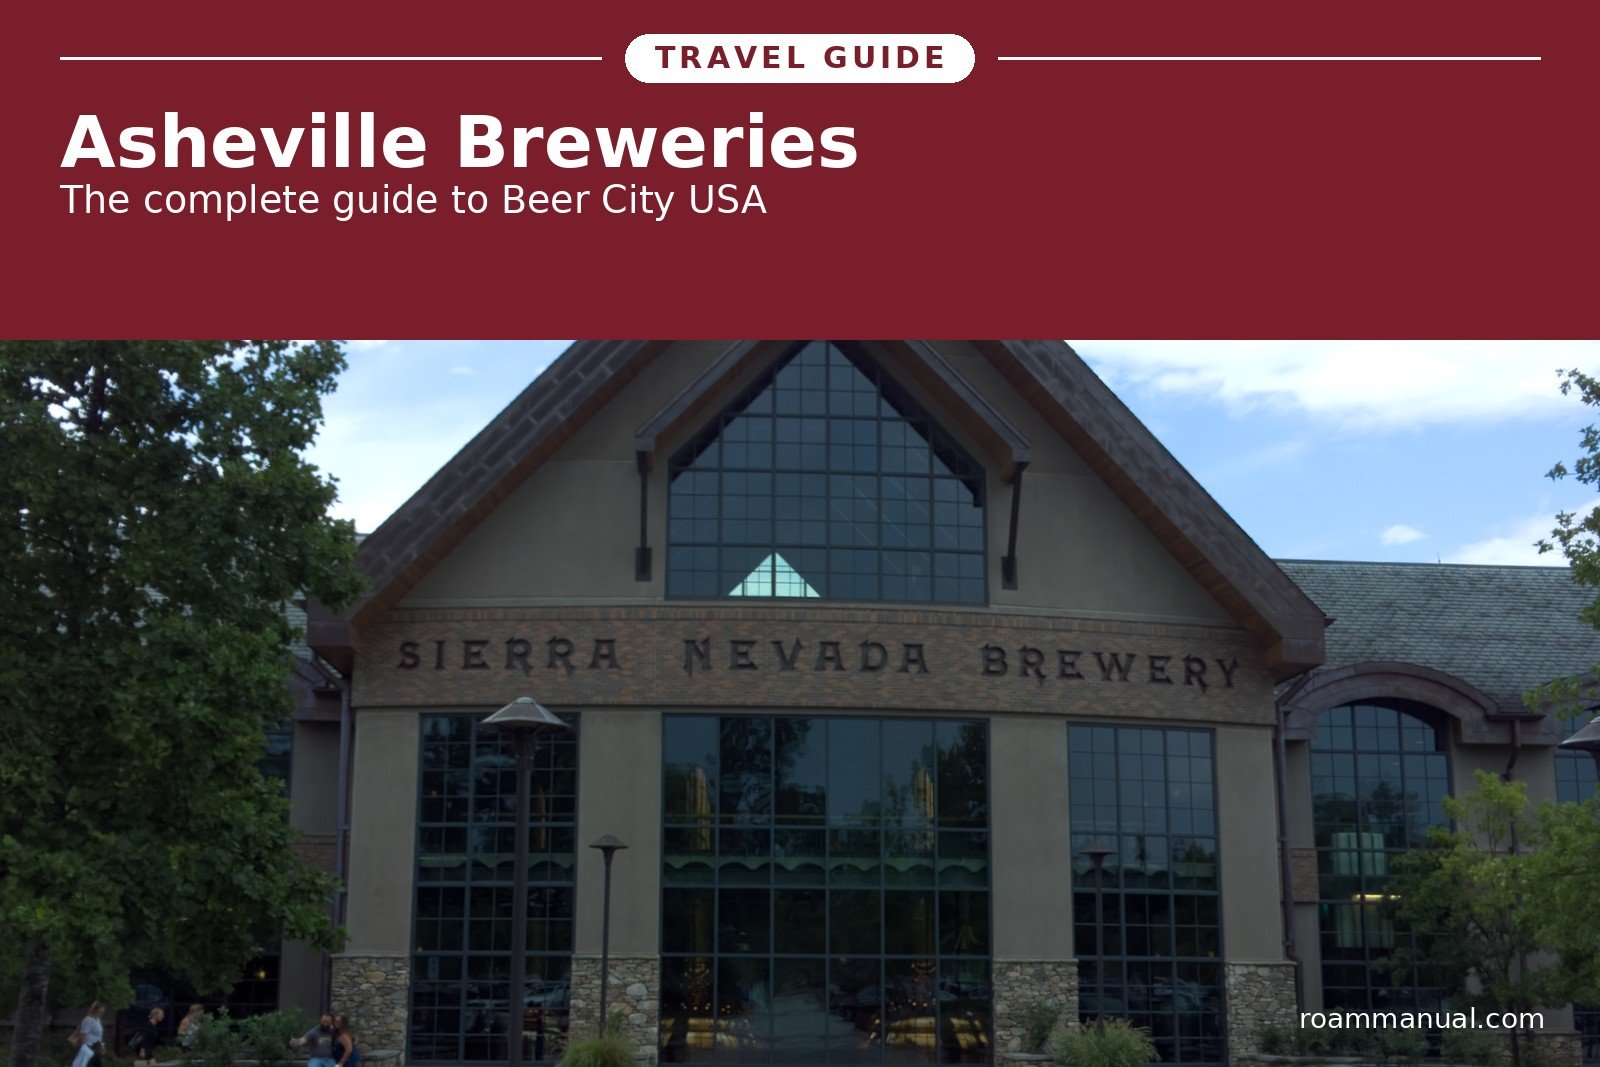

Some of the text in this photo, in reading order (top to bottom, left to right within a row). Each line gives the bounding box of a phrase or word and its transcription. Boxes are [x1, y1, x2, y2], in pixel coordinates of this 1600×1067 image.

[398, 636, 1240, 694] SIERRA NEVADA BREWERY
